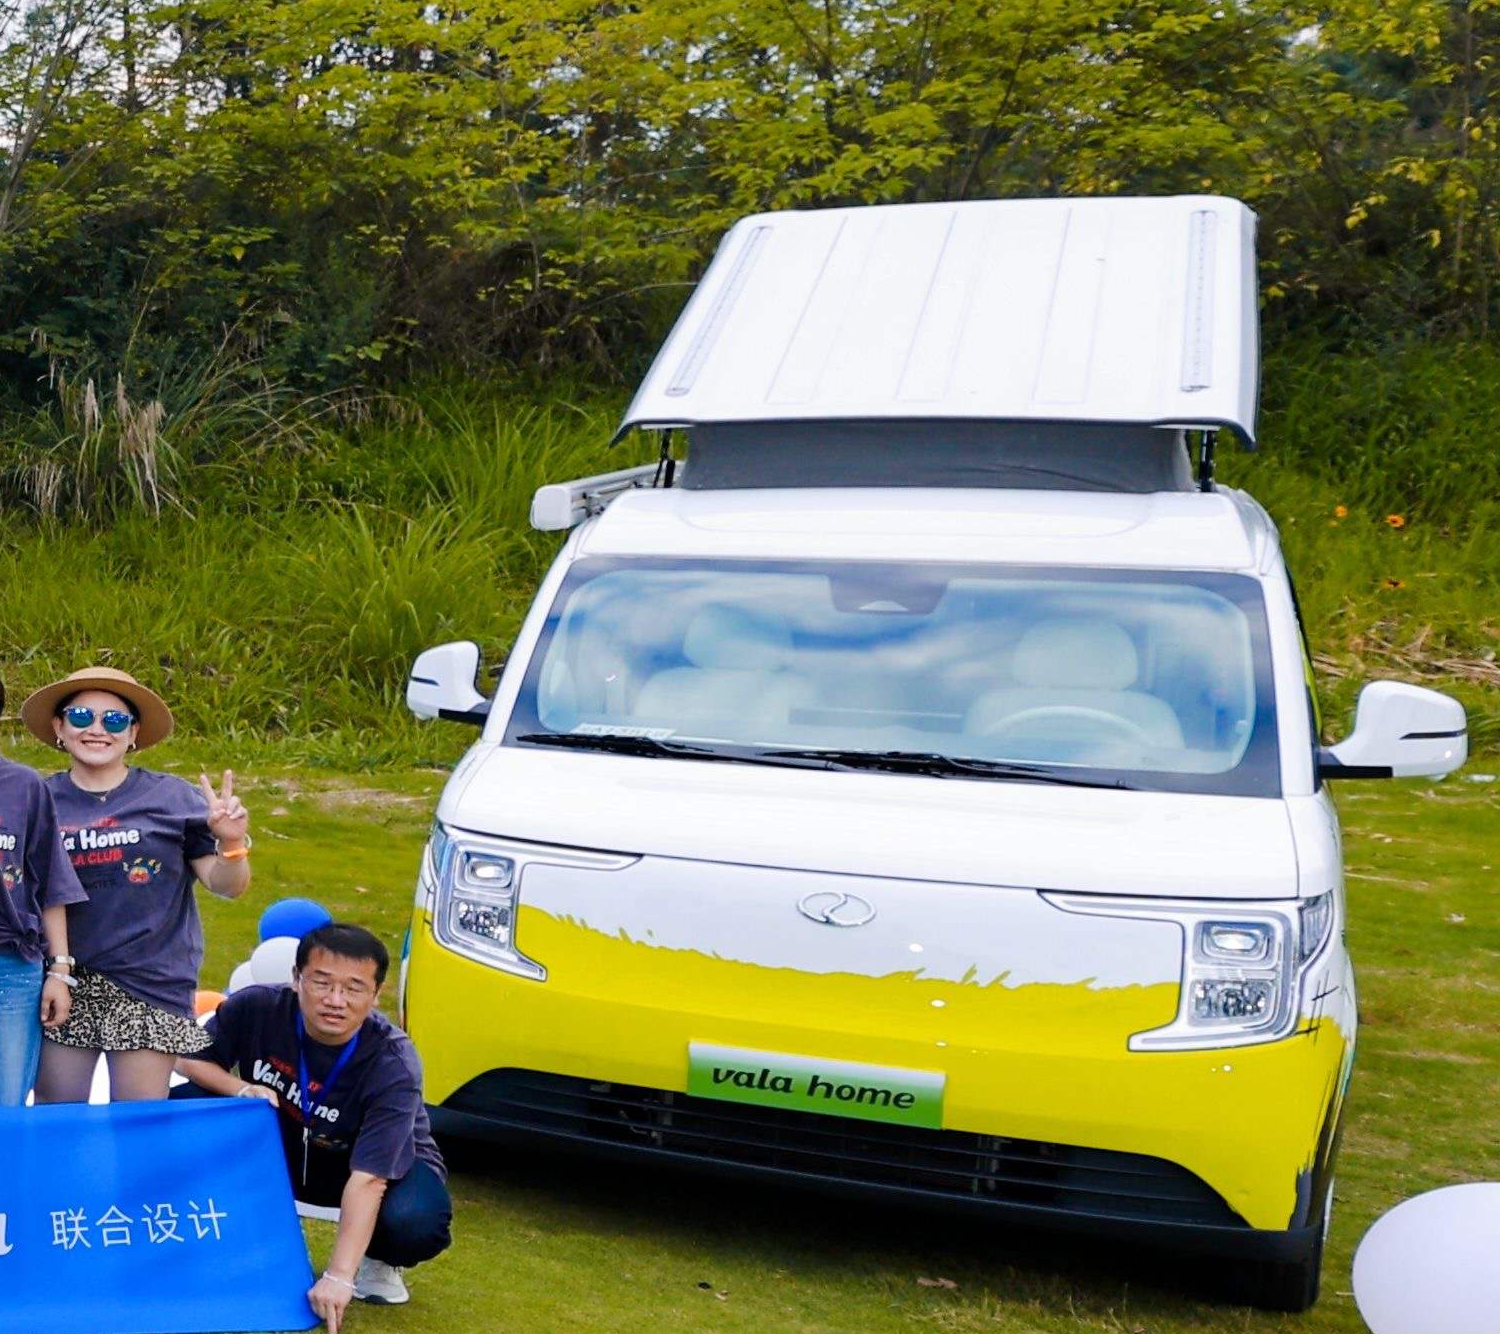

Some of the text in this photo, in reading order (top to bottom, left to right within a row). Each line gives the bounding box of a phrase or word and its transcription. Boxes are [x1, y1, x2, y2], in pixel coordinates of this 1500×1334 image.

[78, 828, 141, 851] Home
[252, 1058, 286, 1093] Vala
[711, 1062, 916, 1112] vala home
[50, 1197, 228, 1253] 联合设计
